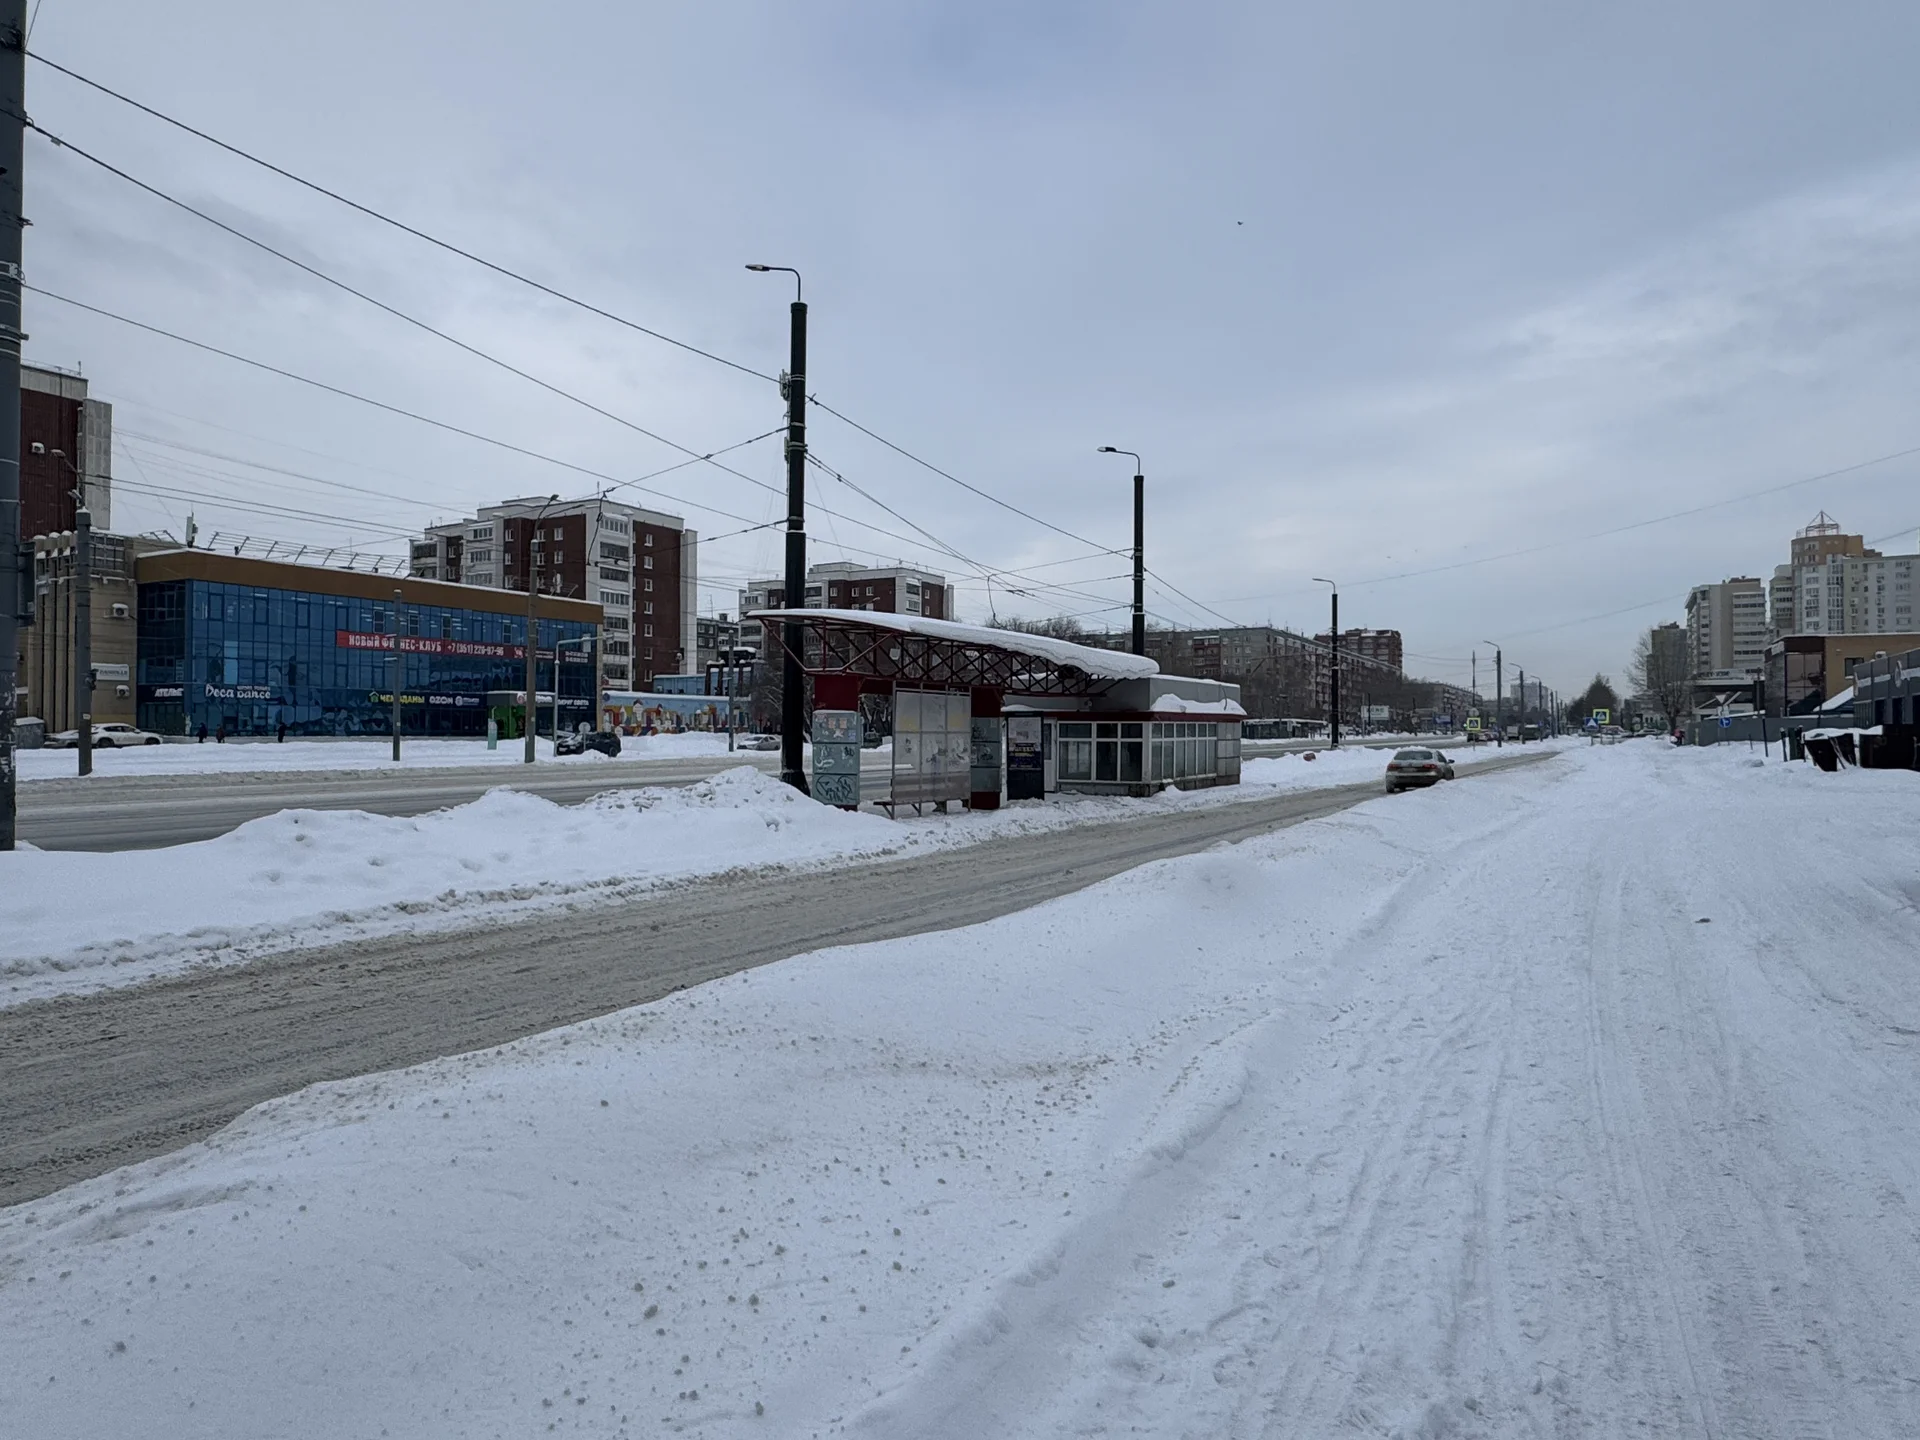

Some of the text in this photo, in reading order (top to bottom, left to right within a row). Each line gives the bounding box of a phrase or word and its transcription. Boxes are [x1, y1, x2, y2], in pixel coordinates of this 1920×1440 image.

[348, 634, 380, 648] НОВЫЙ
[381, 637, 442, 652] ФИНЕС-КЛУБ
[429, 695, 454, 705] OZON
